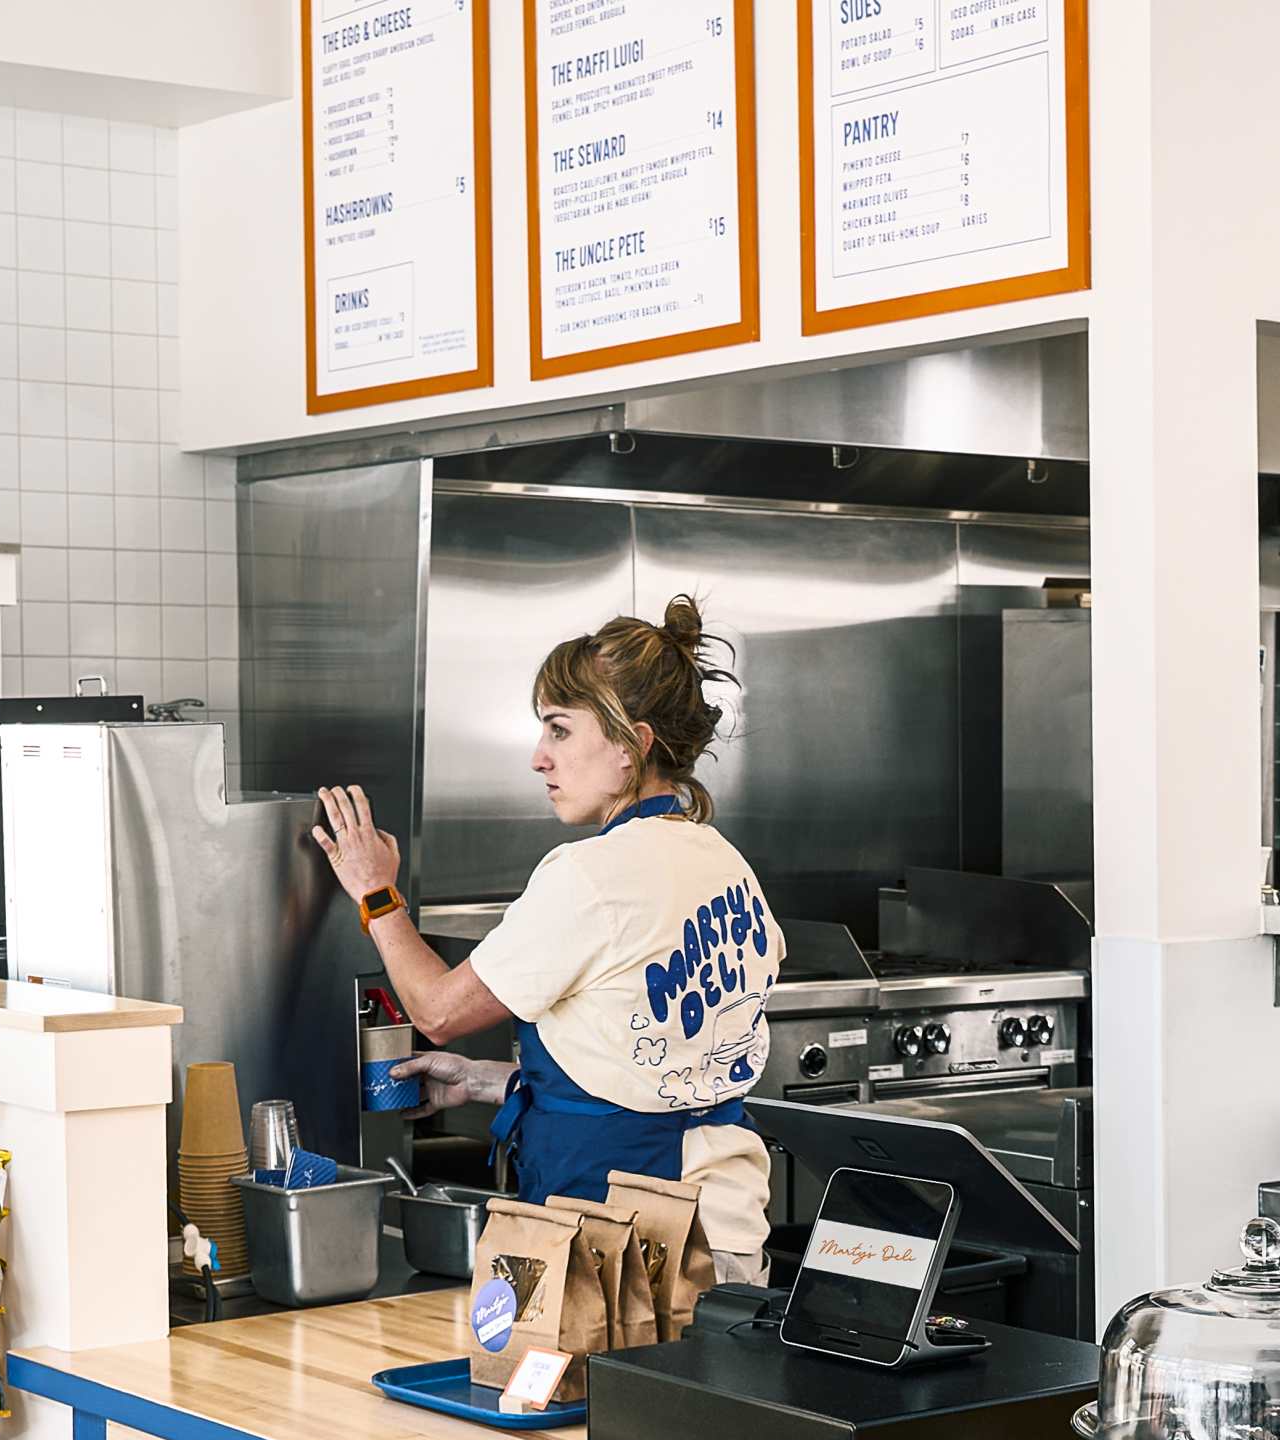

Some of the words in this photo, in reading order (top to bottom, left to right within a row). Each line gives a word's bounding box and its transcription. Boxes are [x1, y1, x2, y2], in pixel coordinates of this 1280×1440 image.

[322, 31, 339, 54] THE
[342, 24, 360, 48] EGG
[363, 21, 369, 40] &
[373, 8, 412, 37] CHEESE
[706, 17, 723, 37] $15
[841, 35, 867, 50] POTATO
[552, 61, 573, 87] THE
[576, 50, 609, 80] RAFFI
[614, 39, 644, 69] LUIGI
[707, 111, 723, 130] $14
[844, 110, 899, 147] PANTRY
[553, 148, 575, 173] THE
[578, 134, 626, 167] SEWARD
[875, 150, 902, 166] CHEESE
[875, 172, 892, 185] FETA
[326, 192, 393, 226] HASHBROWNS
[555, 249, 576, 272] THE
[580, 238, 615, 267] UNCLE
[619, 231, 645, 258] PETE
[709, 217, 726, 236] $15
[335, 288, 369, 313] DRINKS
[819, 1239, 877, 1265] Marty's
[881, 1245, 918, 1262] Deli
